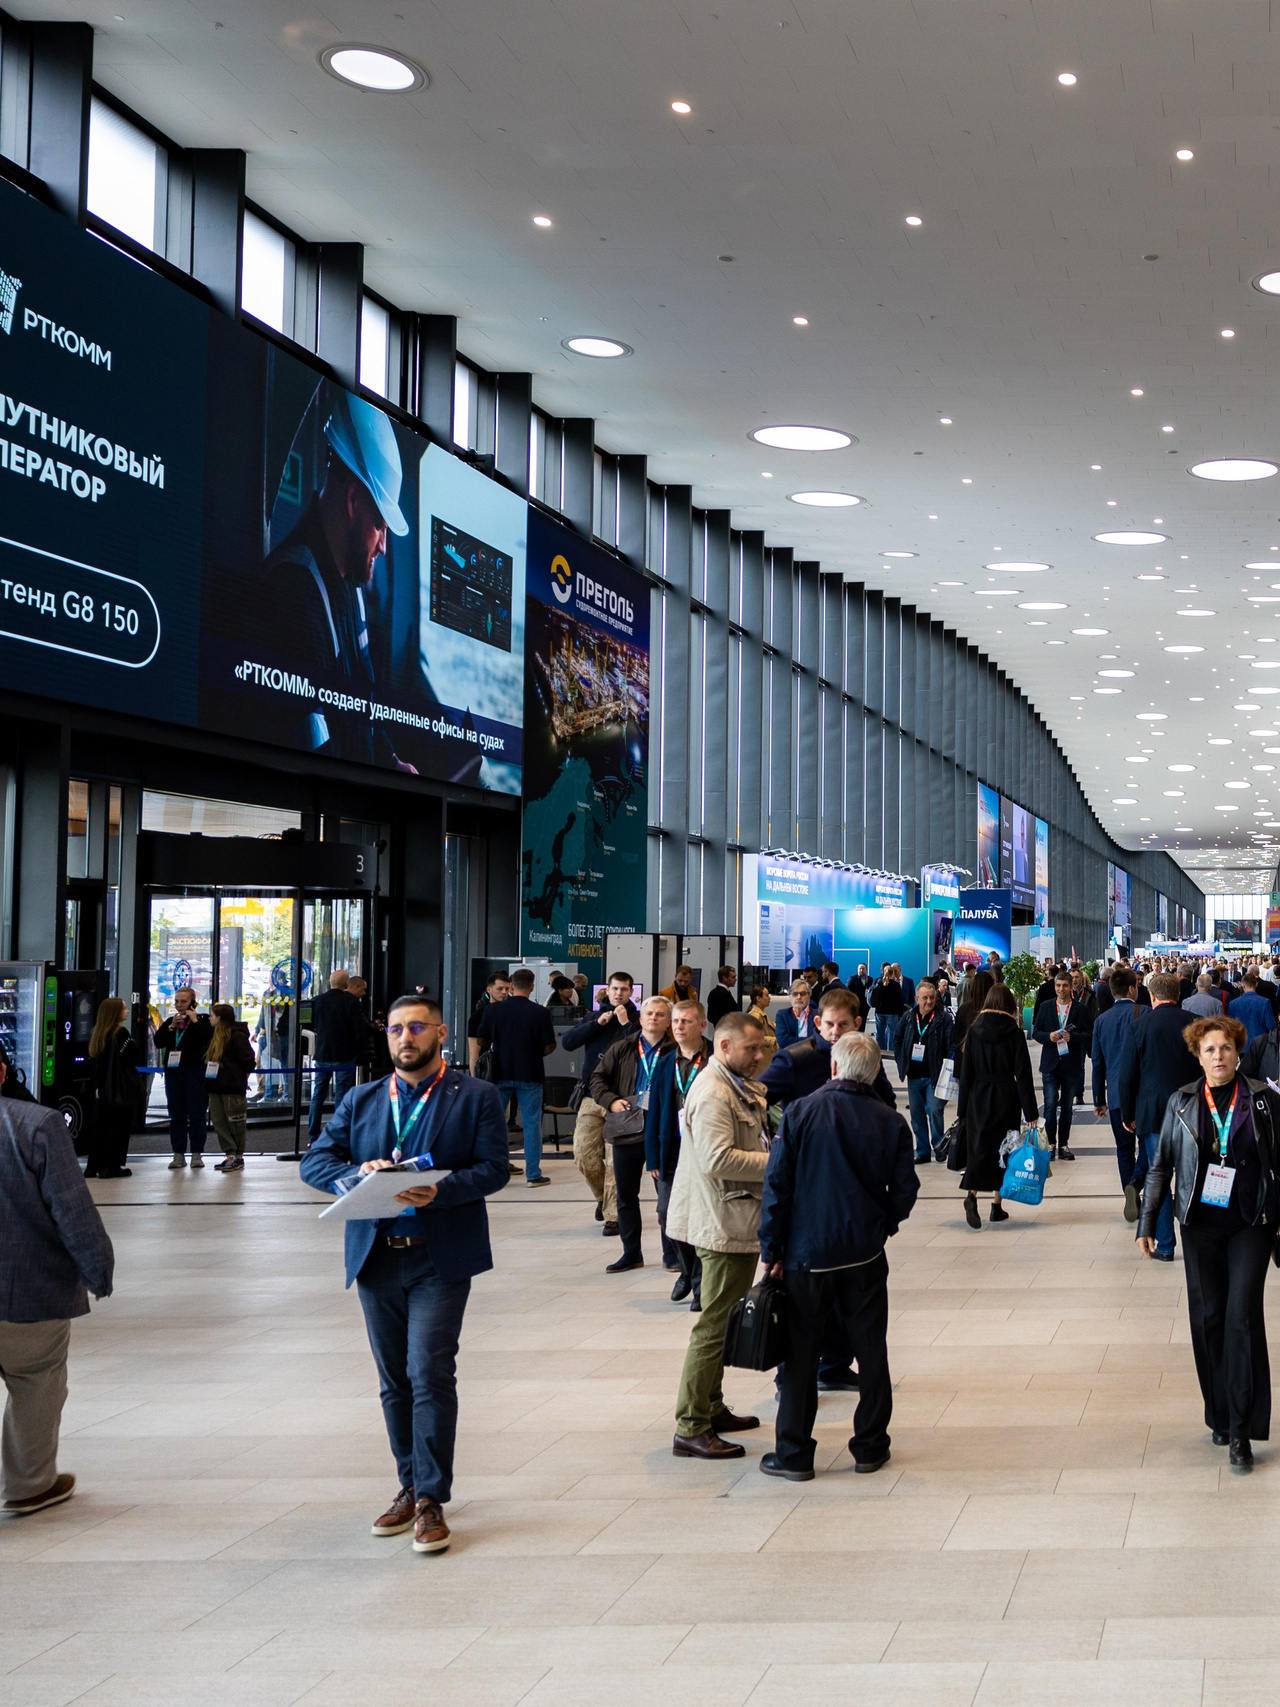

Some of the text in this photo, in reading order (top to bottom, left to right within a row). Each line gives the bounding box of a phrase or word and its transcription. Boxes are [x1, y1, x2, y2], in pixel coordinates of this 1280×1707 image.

[24, 307, 112, 371] РТКОММ
[0, 578, 139, 635] тенд G8 150
[576, 571, 634, 623] ПРЕГОЛЬ
[234, 660, 505, 751] «РТКОММ» создает удаленные офисы на судах
[356, 855, 364, 873] 3
[529, 929, 563, 946] Калининград
